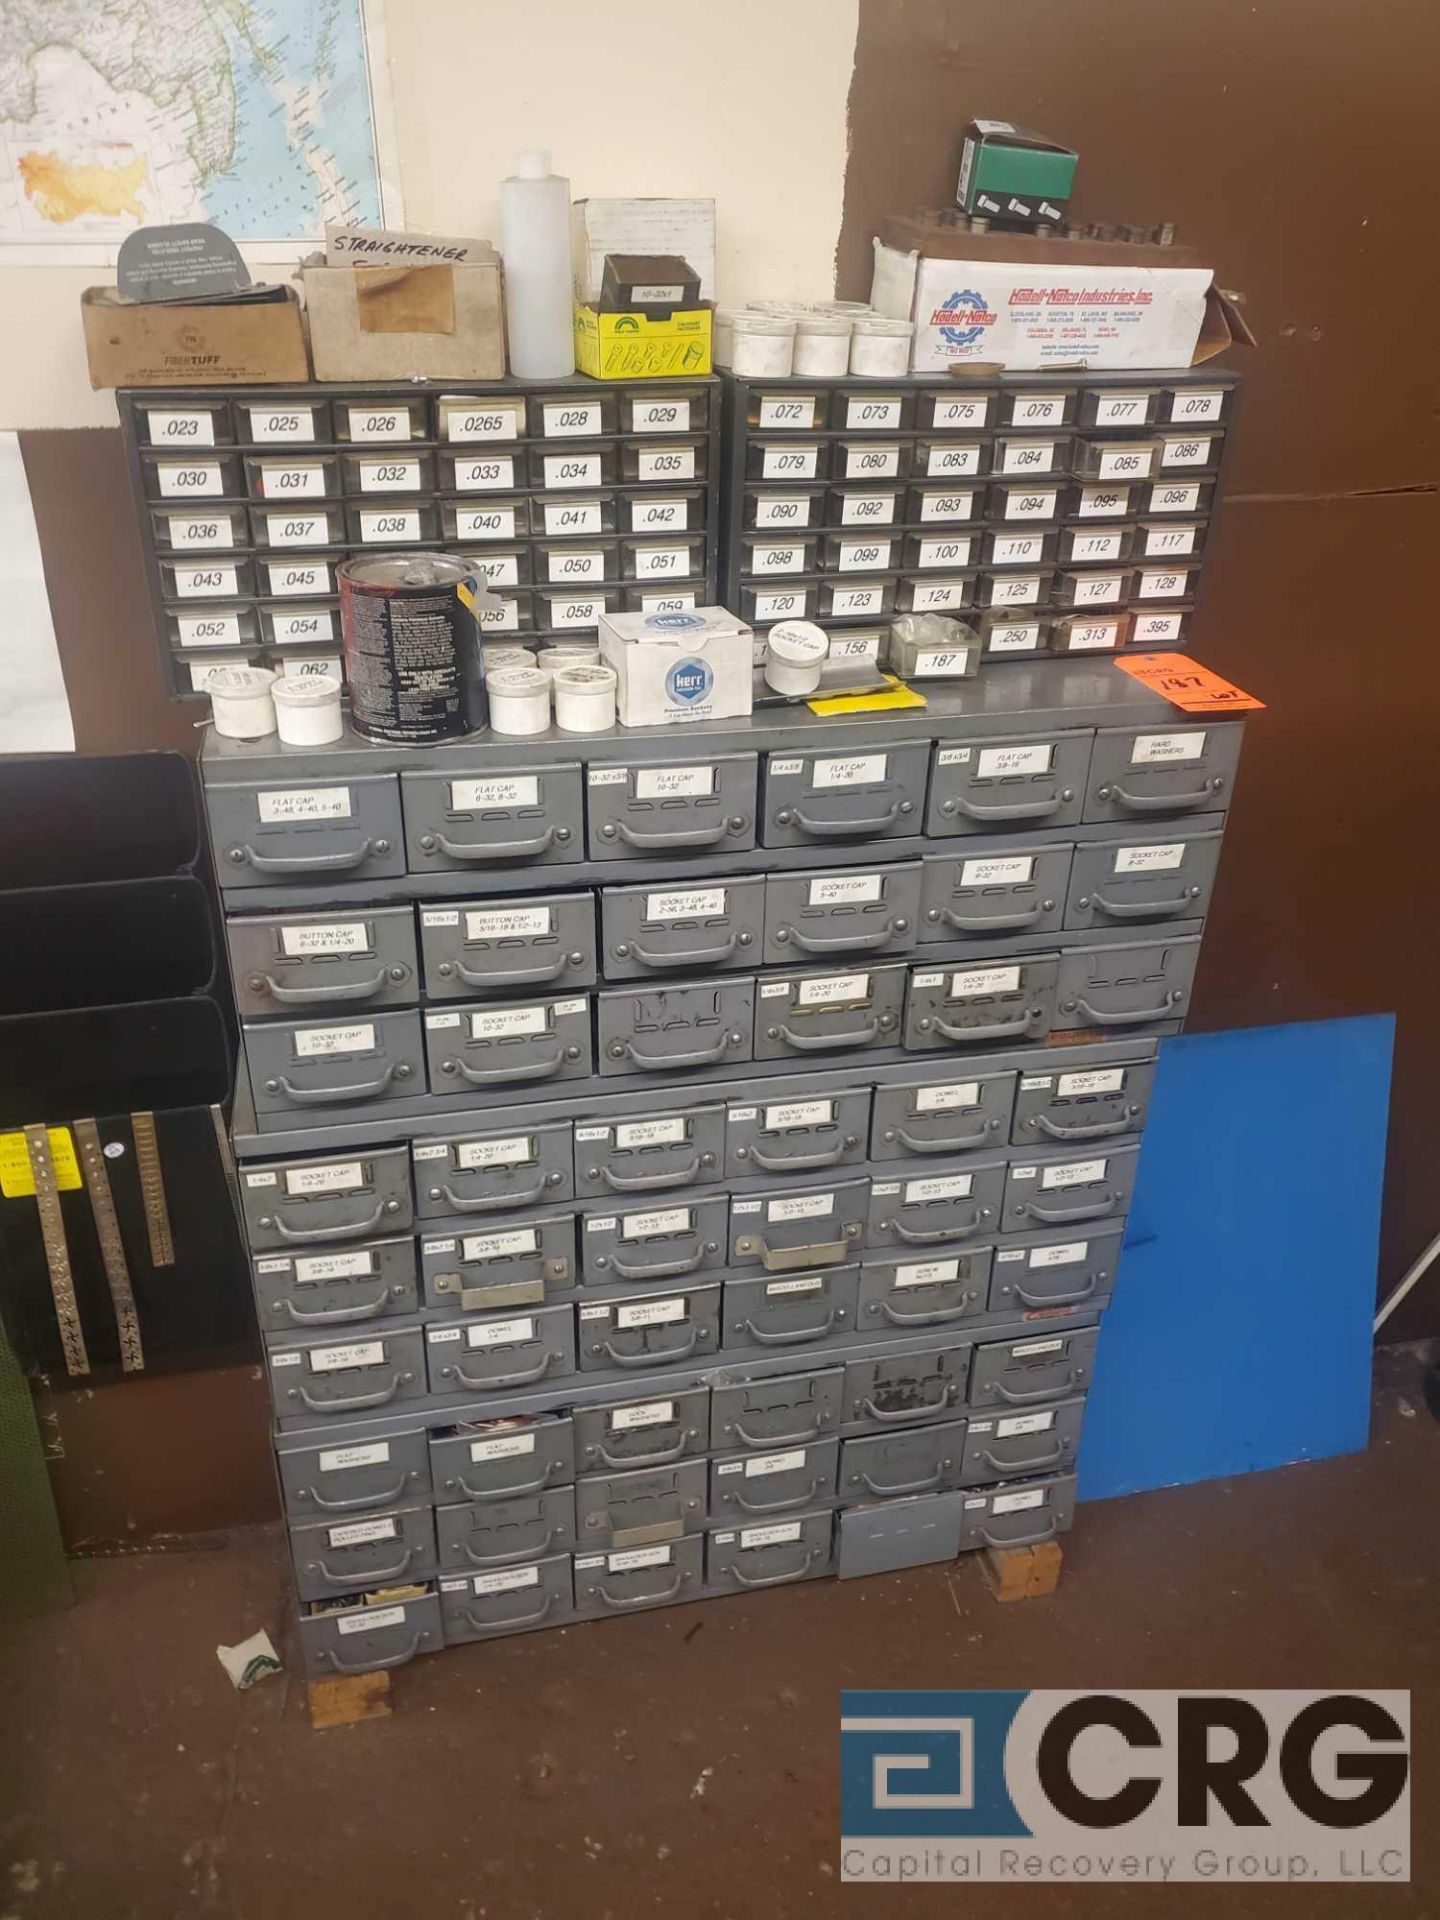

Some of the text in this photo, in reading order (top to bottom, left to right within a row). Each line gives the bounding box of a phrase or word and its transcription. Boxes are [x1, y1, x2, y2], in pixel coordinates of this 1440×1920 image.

[334, 236, 468, 262] STRAIGHTENER
[771, 405, 803, 418] .072
[857, 405, 889, 419] .073
[944, 405, 975, 418] .075
[1023, 403, 1053, 417] .076
[1107, 403, 1138, 416] .077
[1181, 399, 1211, 413] .078
[556, 411, 588, 426] .028
[644, 408, 677, 422] .029
[162, 421, 198, 436] .023
[264, 416, 298, 431] .025
[362, 417, 396, 431] .026
[460, 416, 503, 431] .0265
[1170, 444, 1198, 457] .086
[650, 456, 682, 470] .035
[774, 455, 805, 469] .079
[856, 454, 886, 468] .080
[938, 453, 968, 467] .083
[1014, 451, 1042, 464] .084
[1110, 457, 1140, 470] .085
[372, 467, 406, 481] .032
[467, 465, 500, 480] .033
[555, 464, 587, 478] .034
[172, 472, 207, 486] .030
[275, 473, 307, 488] .031
[1089, 495, 1118, 508] .095
[1160, 490, 1188, 503] .096
[853, 502, 883, 515] .092
[931, 499, 961, 512] .093
[1016, 498, 1044, 511] .094
[556, 511, 586, 525] .041
[643, 508, 675, 522] .042
[767, 505, 798, 518] .090
[373, 518, 406, 532] .038
[468, 515, 501, 529] .040
[183, 524, 218, 538] .036
[280, 522, 314, 537] .037
[1081, 539, 1111, 552] .112
[1155, 534, 1184, 547] .117
[849, 547, 879, 561] .099
[929, 545, 958, 558] .100
[1003, 541, 1032, 555] .110
[646, 555, 675, 569] .051
[763, 551, 793, 565] .098
[480, 565, 505, 577] 47
[560, 559, 591, 572] .050
[189, 572, 222, 587] .043
[282, 571, 315, 585] .045
[1149, 577, 1176, 589] .128
[923, 590, 951, 602] .124
[1000, 584, 1028, 597] .125
[1083, 583, 1112, 596] .127
[657, 601, 683, 611] 059
[765, 597, 795, 610] .120
[842, 593, 872, 607] .123
[481, 609, 505, 622] 56
[562, 605, 593, 618] .058
[192, 622, 225, 637] .052
[286, 619, 318, 634] .054
[1144, 621, 1171, 632] .395
[999, 630, 1027, 643] .250
[1078, 629, 1107, 641] .313
[838, 641, 868, 654] .156
[925, 654, 956, 668] .187
[301, 663, 328, 676] 062
[677, 674, 702, 687] kerr
[1151, 740, 1171, 748] HARD
[997, 752, 1032, 762] FLAT CAP
[830, 762, 866, 772] FLAT CAP
[656, 774, 694, 783] FLAT CAP
[474, 784, 515, 794] FLAT CAP
[272, 796, 314, 806] FLAT CAP
[1129, 851, 1158, 859] SOCKET
[976, 864, 1005, 872] SOCKET
[820, 883, 851, 892] SOCKET
[659, 896, 708, 906] SOCKET CAP
[479, 916, 511, 925] BUTTON
[299, 930, 353, 940] BUTTON CAP
[962, 973, 1007, 983] SOCKET CAP
[809, 981, 854, 991] SOCKET CAP
[482, 1016, 513, 1024] SOCKET
[310, 1031, 361, 1041] SOCKET CAP
